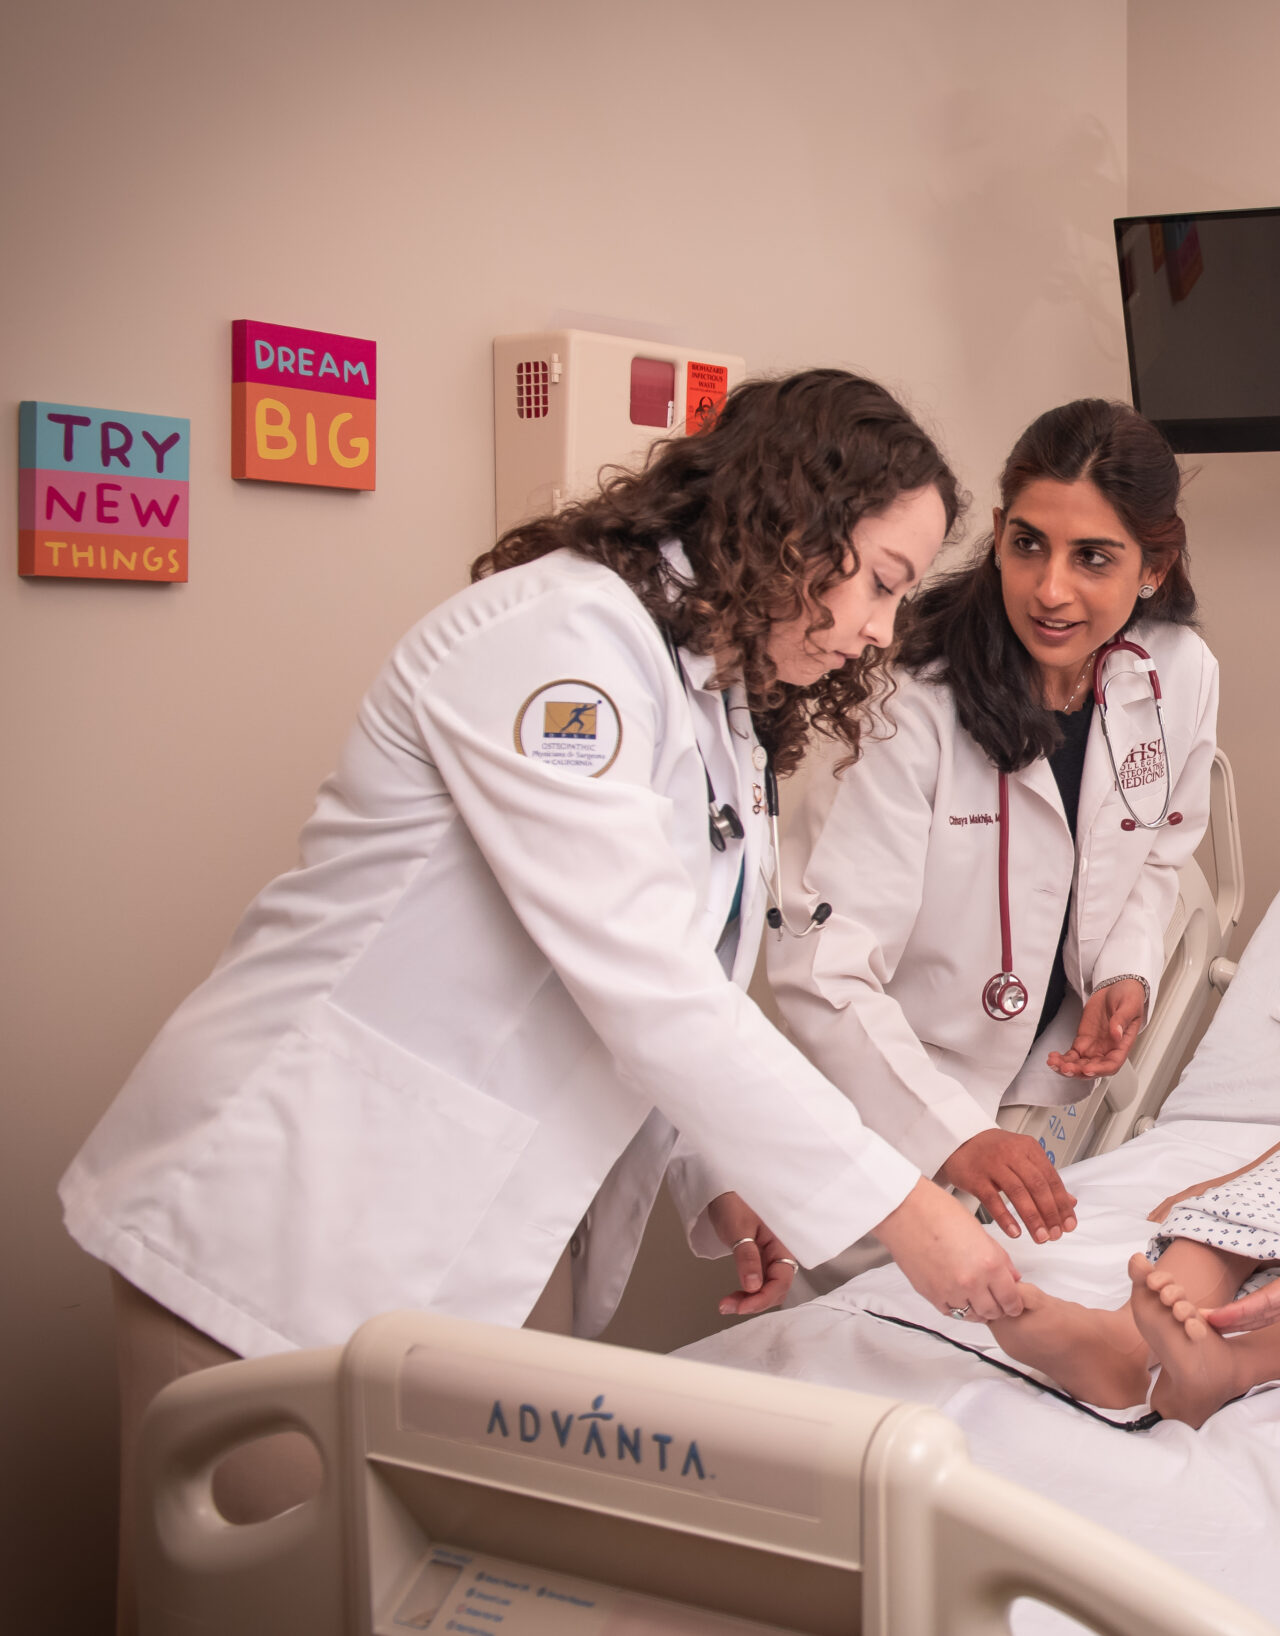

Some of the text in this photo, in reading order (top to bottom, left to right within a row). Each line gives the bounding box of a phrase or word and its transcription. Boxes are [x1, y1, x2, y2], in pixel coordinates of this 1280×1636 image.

[254, 339, 369, 386] DREAM
[691, 364, 724, 374] BIOHAZARD
[692, 372, 723, 382] INFECTIOUS
[698, 381, 716, 389] WASTE
[47, 413, 181, 474] TRY
[255, 397, 369, 469] BIG
[45, 483, 180, 528] NEW
[44, 541, 180, 574] THINGS
[486, 1395, 706, 1480] ADVANTA
